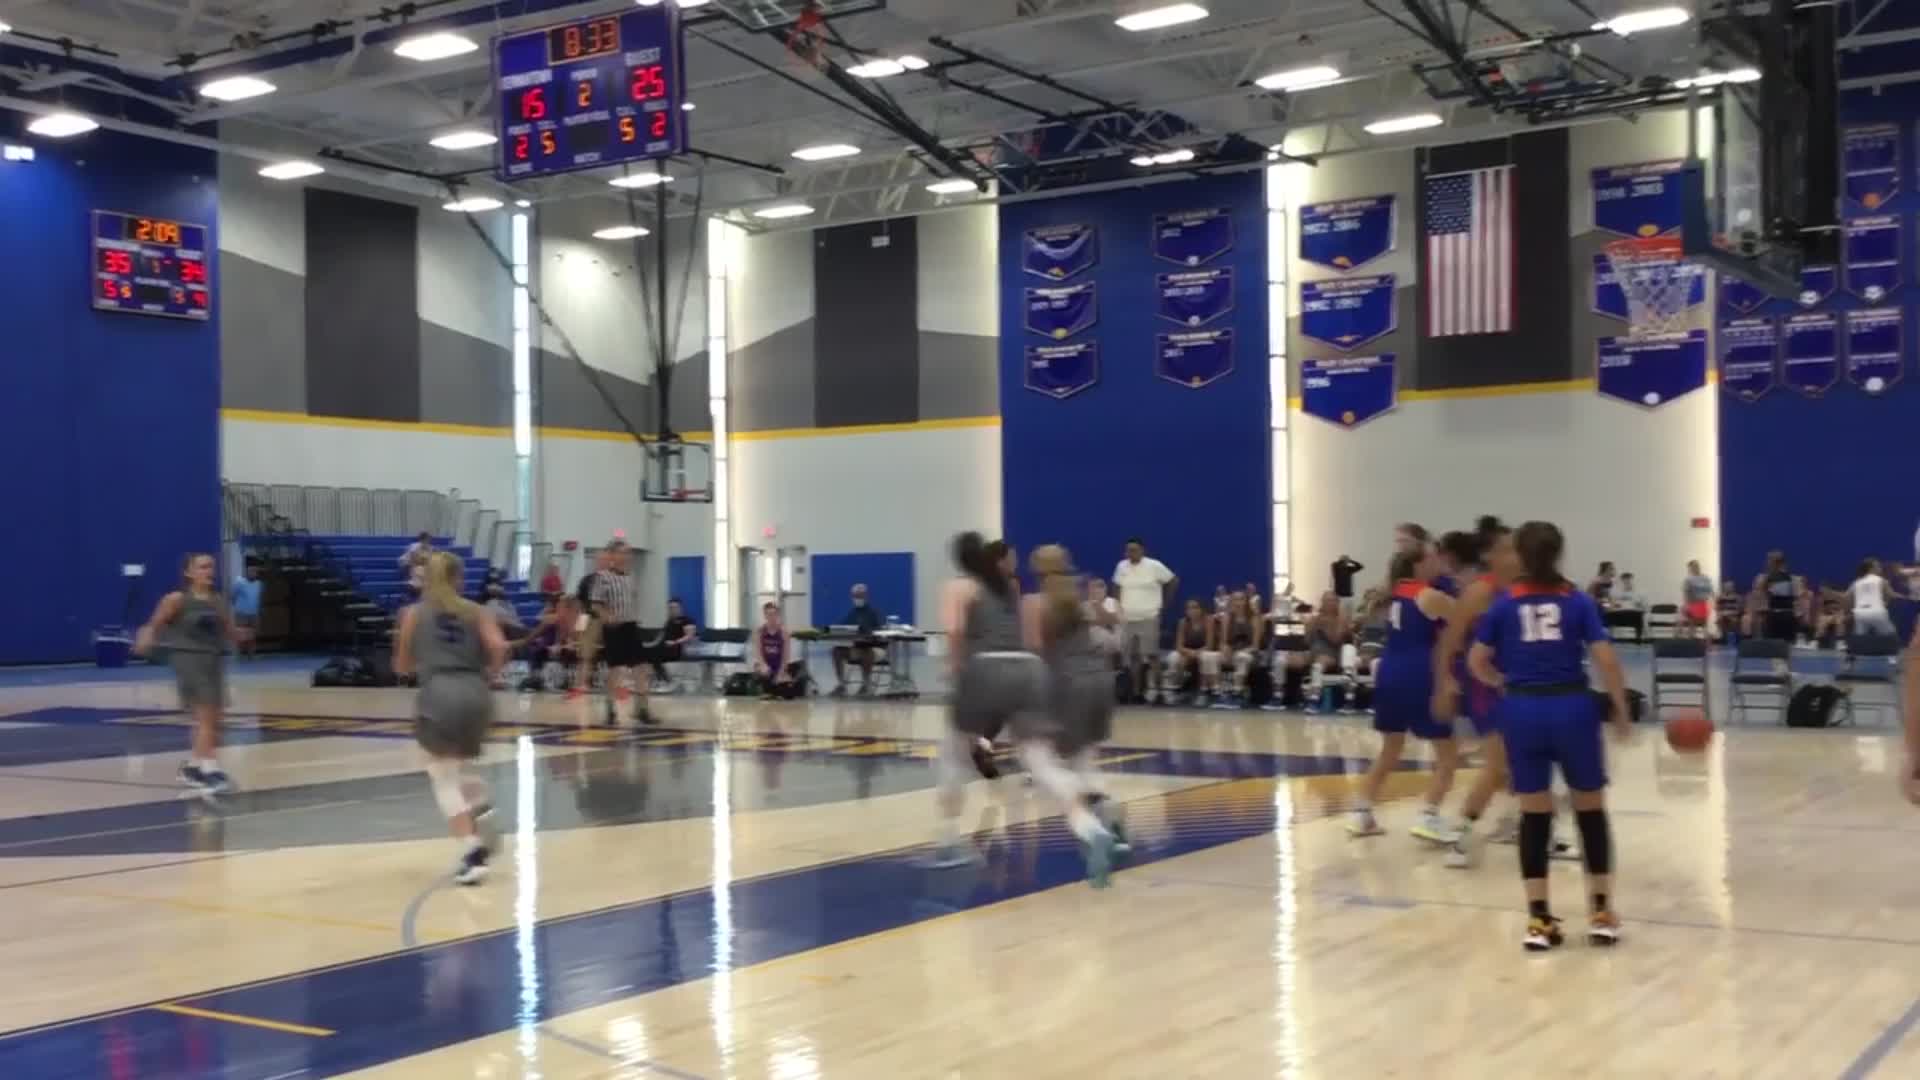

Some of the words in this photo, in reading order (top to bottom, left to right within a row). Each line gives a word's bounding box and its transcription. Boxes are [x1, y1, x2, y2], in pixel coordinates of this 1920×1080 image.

[578, 82, 592, 107] 2
[632, 66, 665, 100] 25
[619, 117, 636, 141] 5
[652, 112, 666, 136] 2
[515, 136, 528, 158] 2
[541, 131, 556, 154] 5
[105, 251, 131, 274] 35
[104, 280, 118, 298] 5
[1518, 602, 1562, 643] 12
